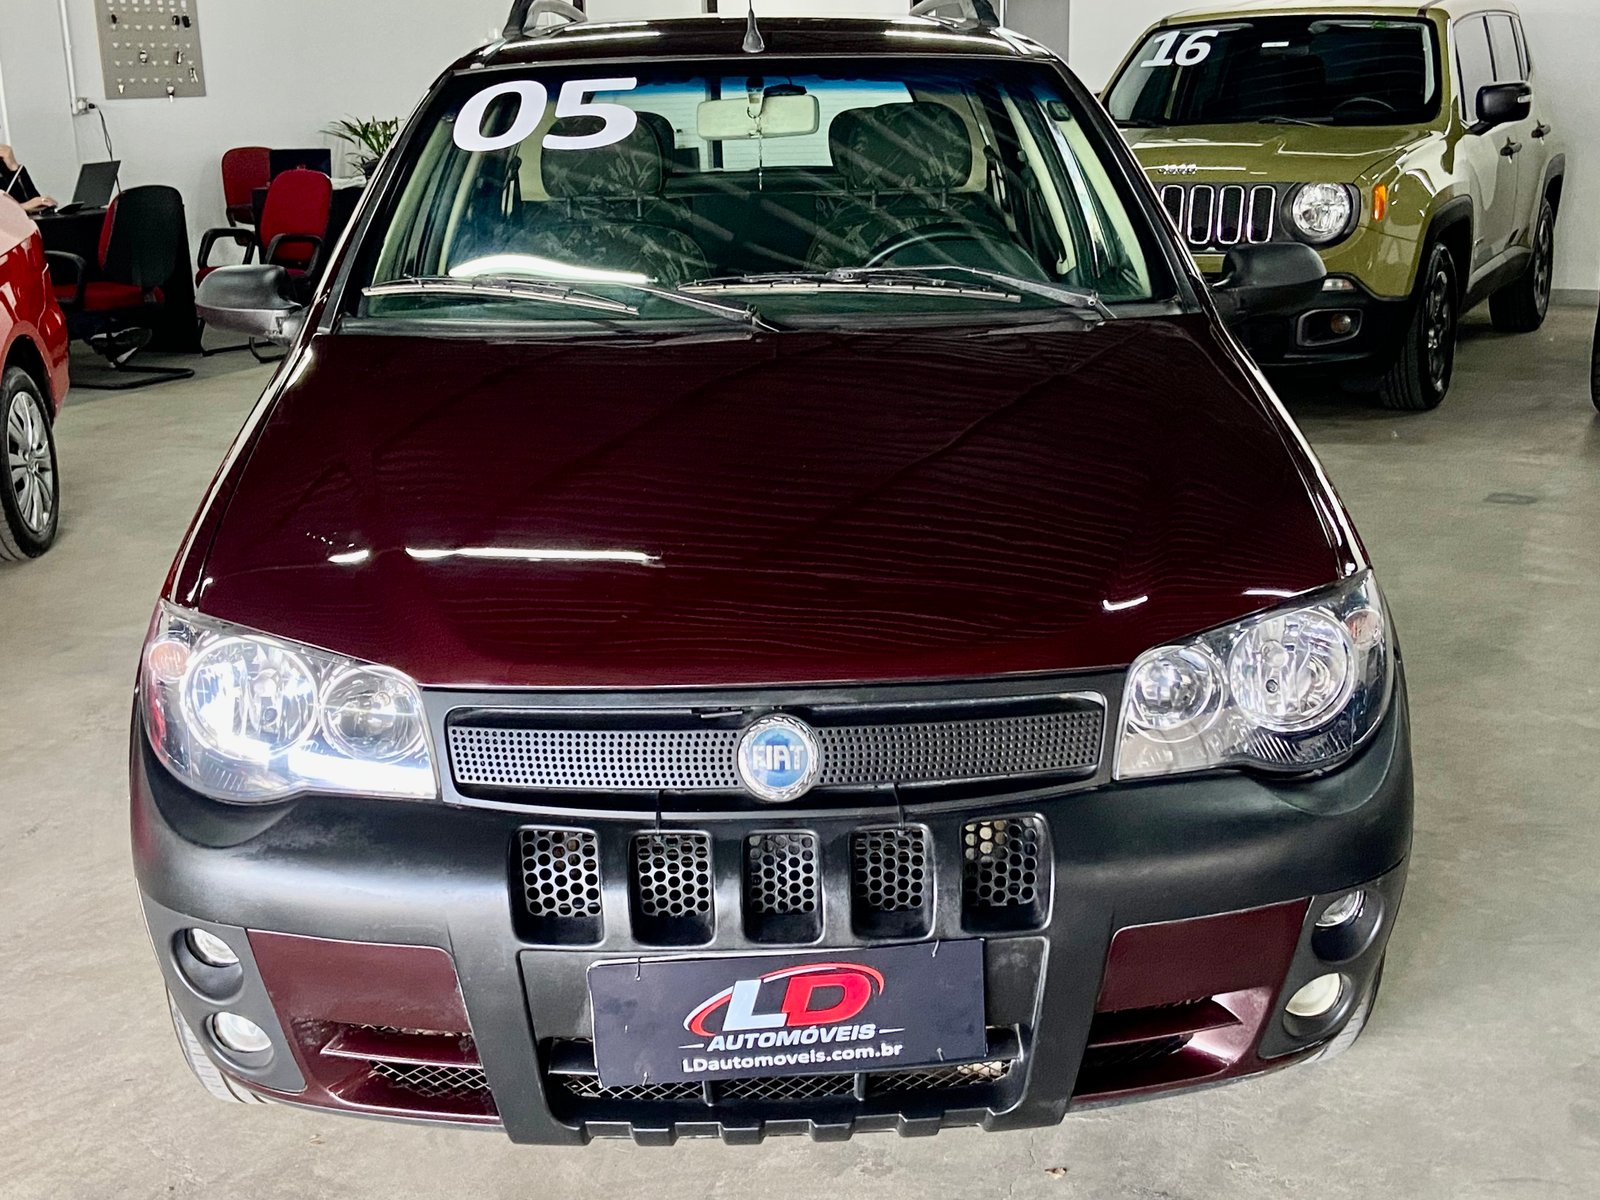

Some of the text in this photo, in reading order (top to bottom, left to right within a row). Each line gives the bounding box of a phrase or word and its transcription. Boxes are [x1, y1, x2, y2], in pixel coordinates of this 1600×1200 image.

[1141, 30, 1219, 67] 16
[453, 78, 638, 152] 05
[752, 745, 804, 770] FIAT
[722, 973, 873, 1032] LD
[707, 1024, 875, 1052] AUTOMÓVEIS
[682, 1043, 904, 1073] LDautomoveis.com.br
